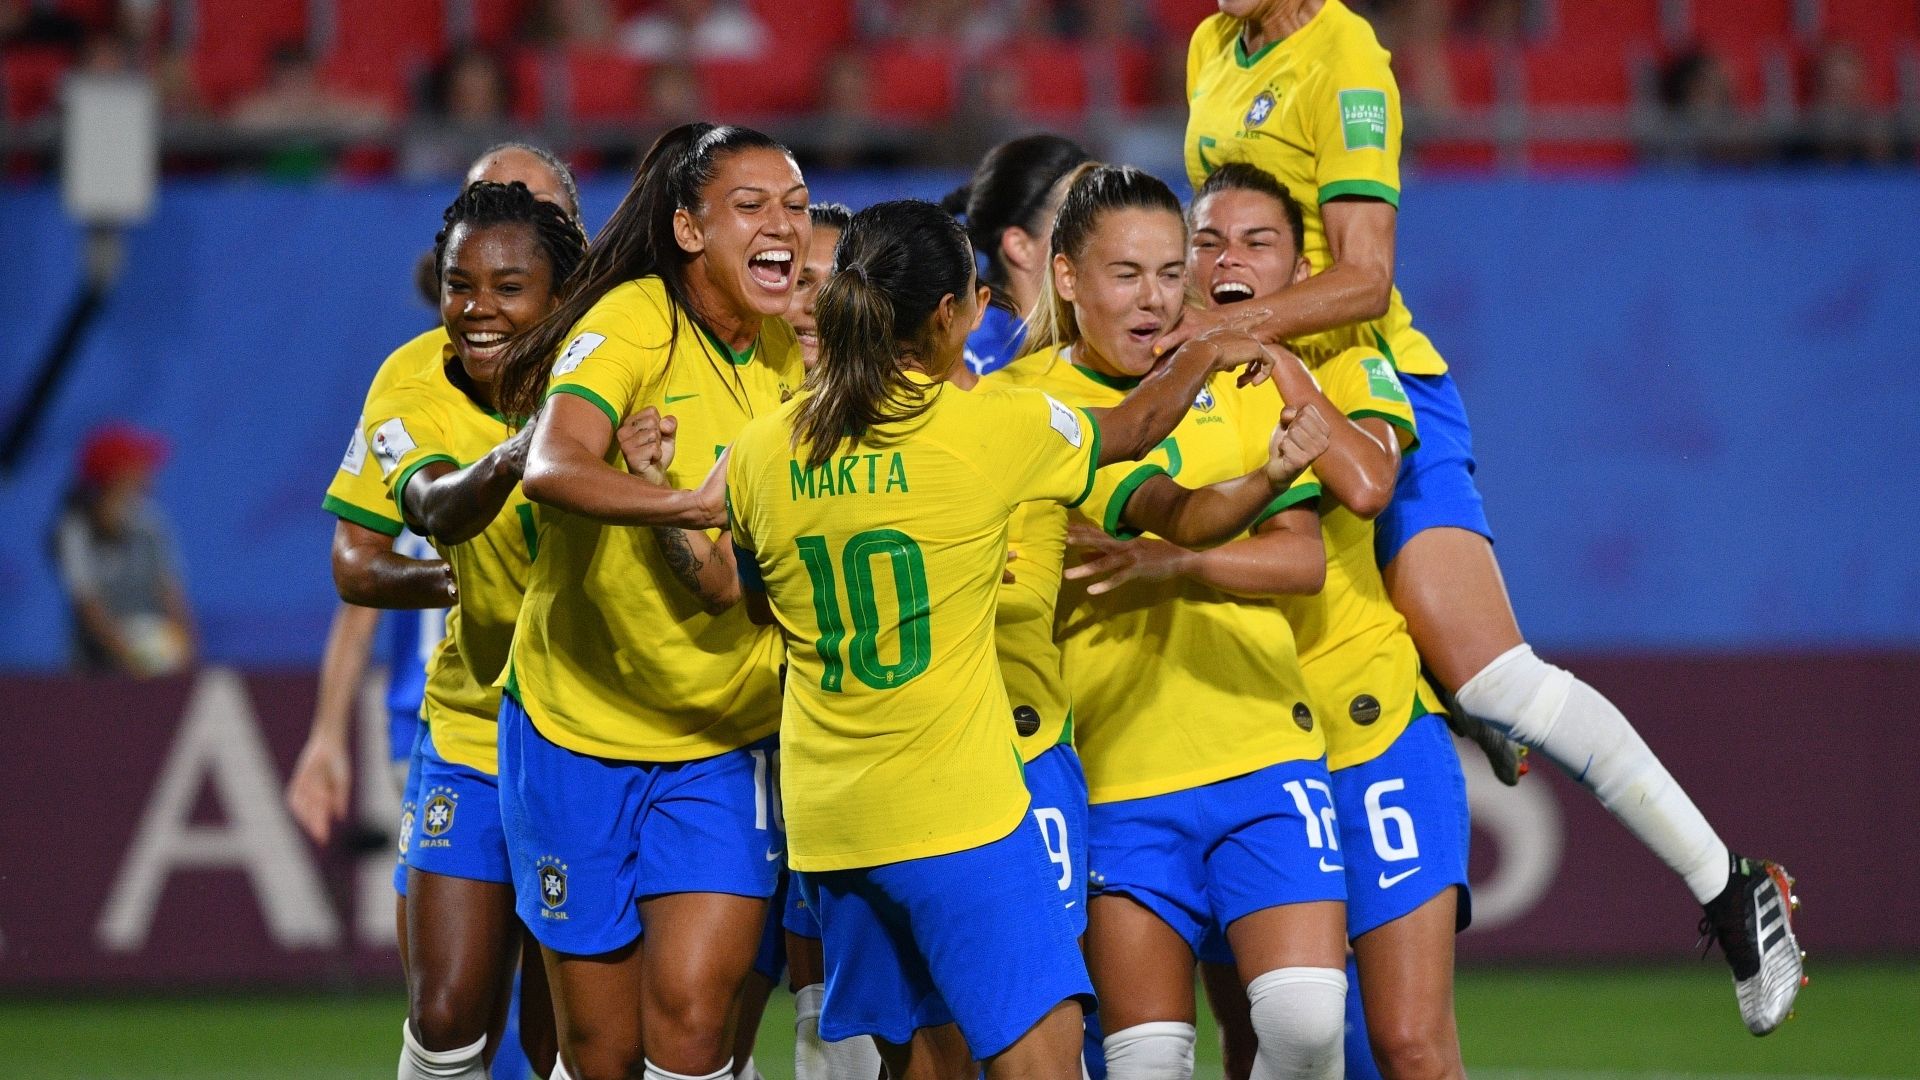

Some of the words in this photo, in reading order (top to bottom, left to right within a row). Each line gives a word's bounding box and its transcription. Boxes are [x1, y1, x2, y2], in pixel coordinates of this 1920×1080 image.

[1196, 416, 1225, 425] BRASIL
[789, 452, 909, 501] MARTA
[795, 529, 931, 692] 10
[420, 839, 451, 848] BRASIL
[1282, 778, 1338, 851] 12
[1364, 778, 1419, 862] 6
[1032, 807, 1072, 891] 9
[541, 908, 569, 919] BRASIL
